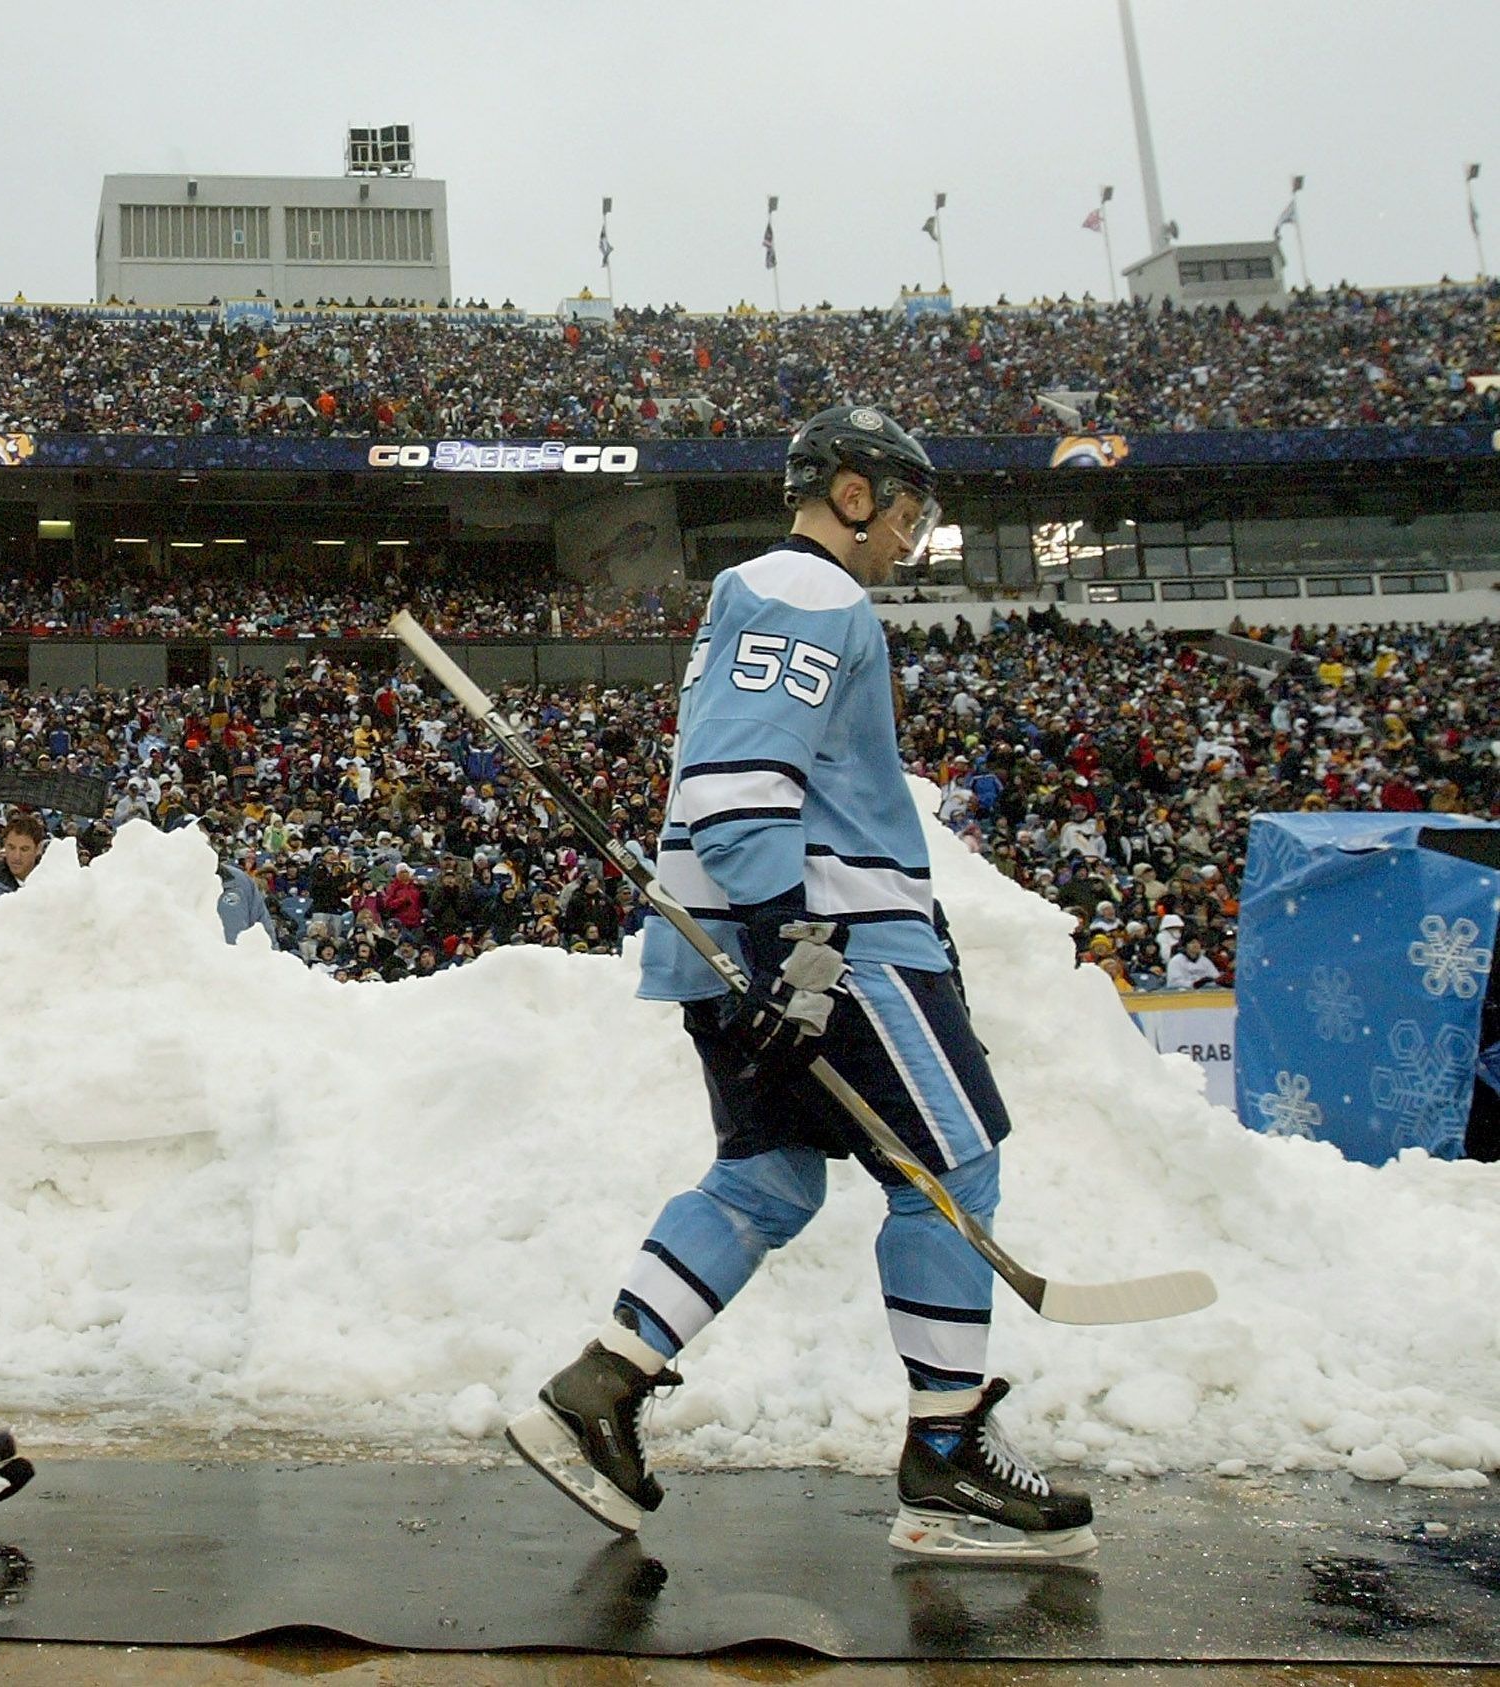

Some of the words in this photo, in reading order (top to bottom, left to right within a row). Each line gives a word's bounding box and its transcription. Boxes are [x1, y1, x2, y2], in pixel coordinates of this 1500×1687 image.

[368, 445, 430, 467] GO
[433, 441, 566, 471] SABRES
[562, 446, 639, 473] GO
[730, 630, 841, 709] 55
[1176, 1043, 1232, 1062] GRAB
